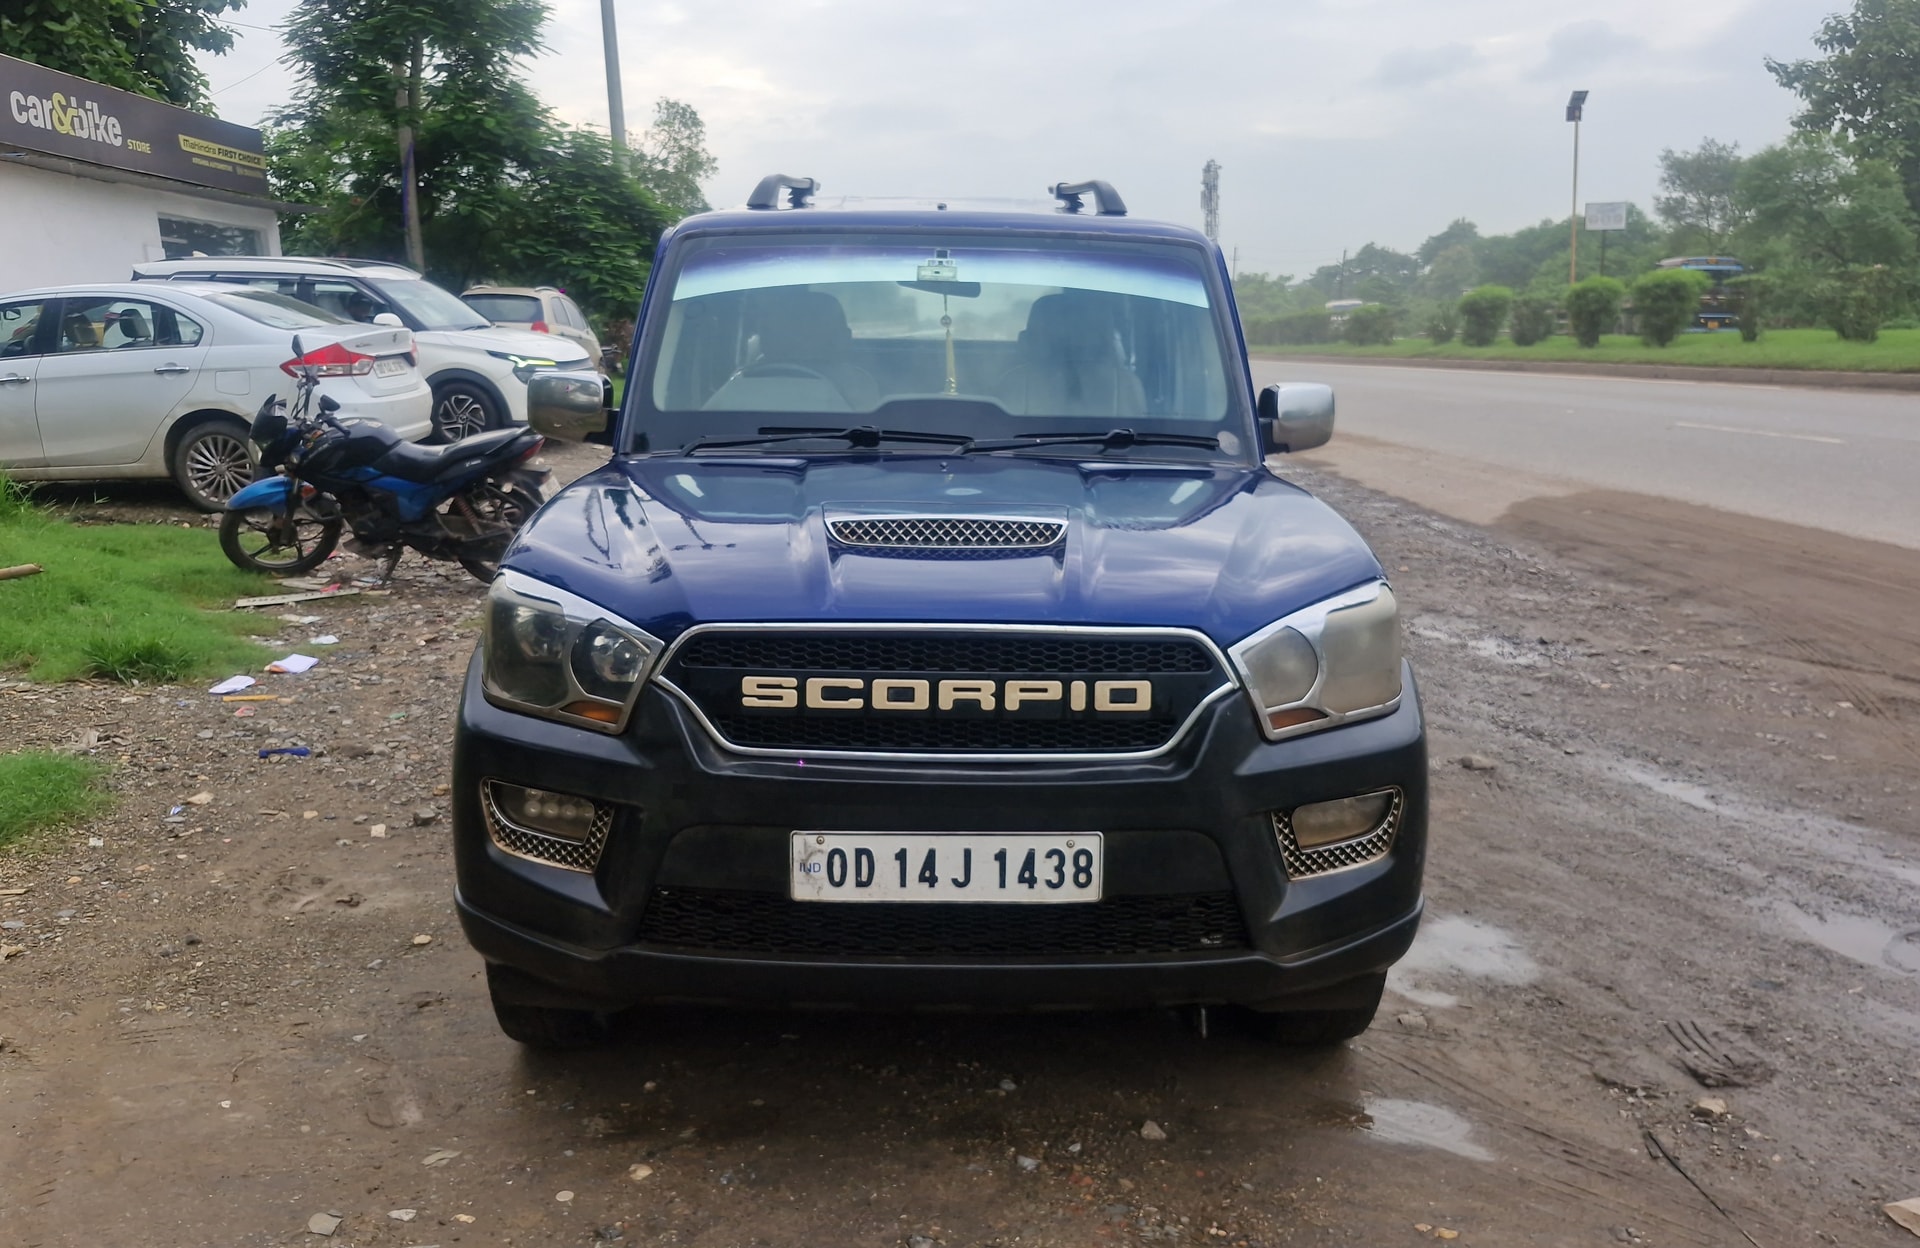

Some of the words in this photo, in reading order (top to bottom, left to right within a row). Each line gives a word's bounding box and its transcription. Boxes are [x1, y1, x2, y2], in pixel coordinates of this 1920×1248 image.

[10, 90, 122, 147] car&bike
[127, 139, 152, 154] STORE
[217, 148, 237, 160] FIRST
[238, 153, 262, 166] CHOICE
[742, 676, 1152, 711] SCORPIO
[799, 862, 821, 874] IND
[826, 847, 876, 888] OD
[894, 848, 939, 889] 14
[951, 848, 973, 889] J
[994, 848, 1094, 890] 1438
